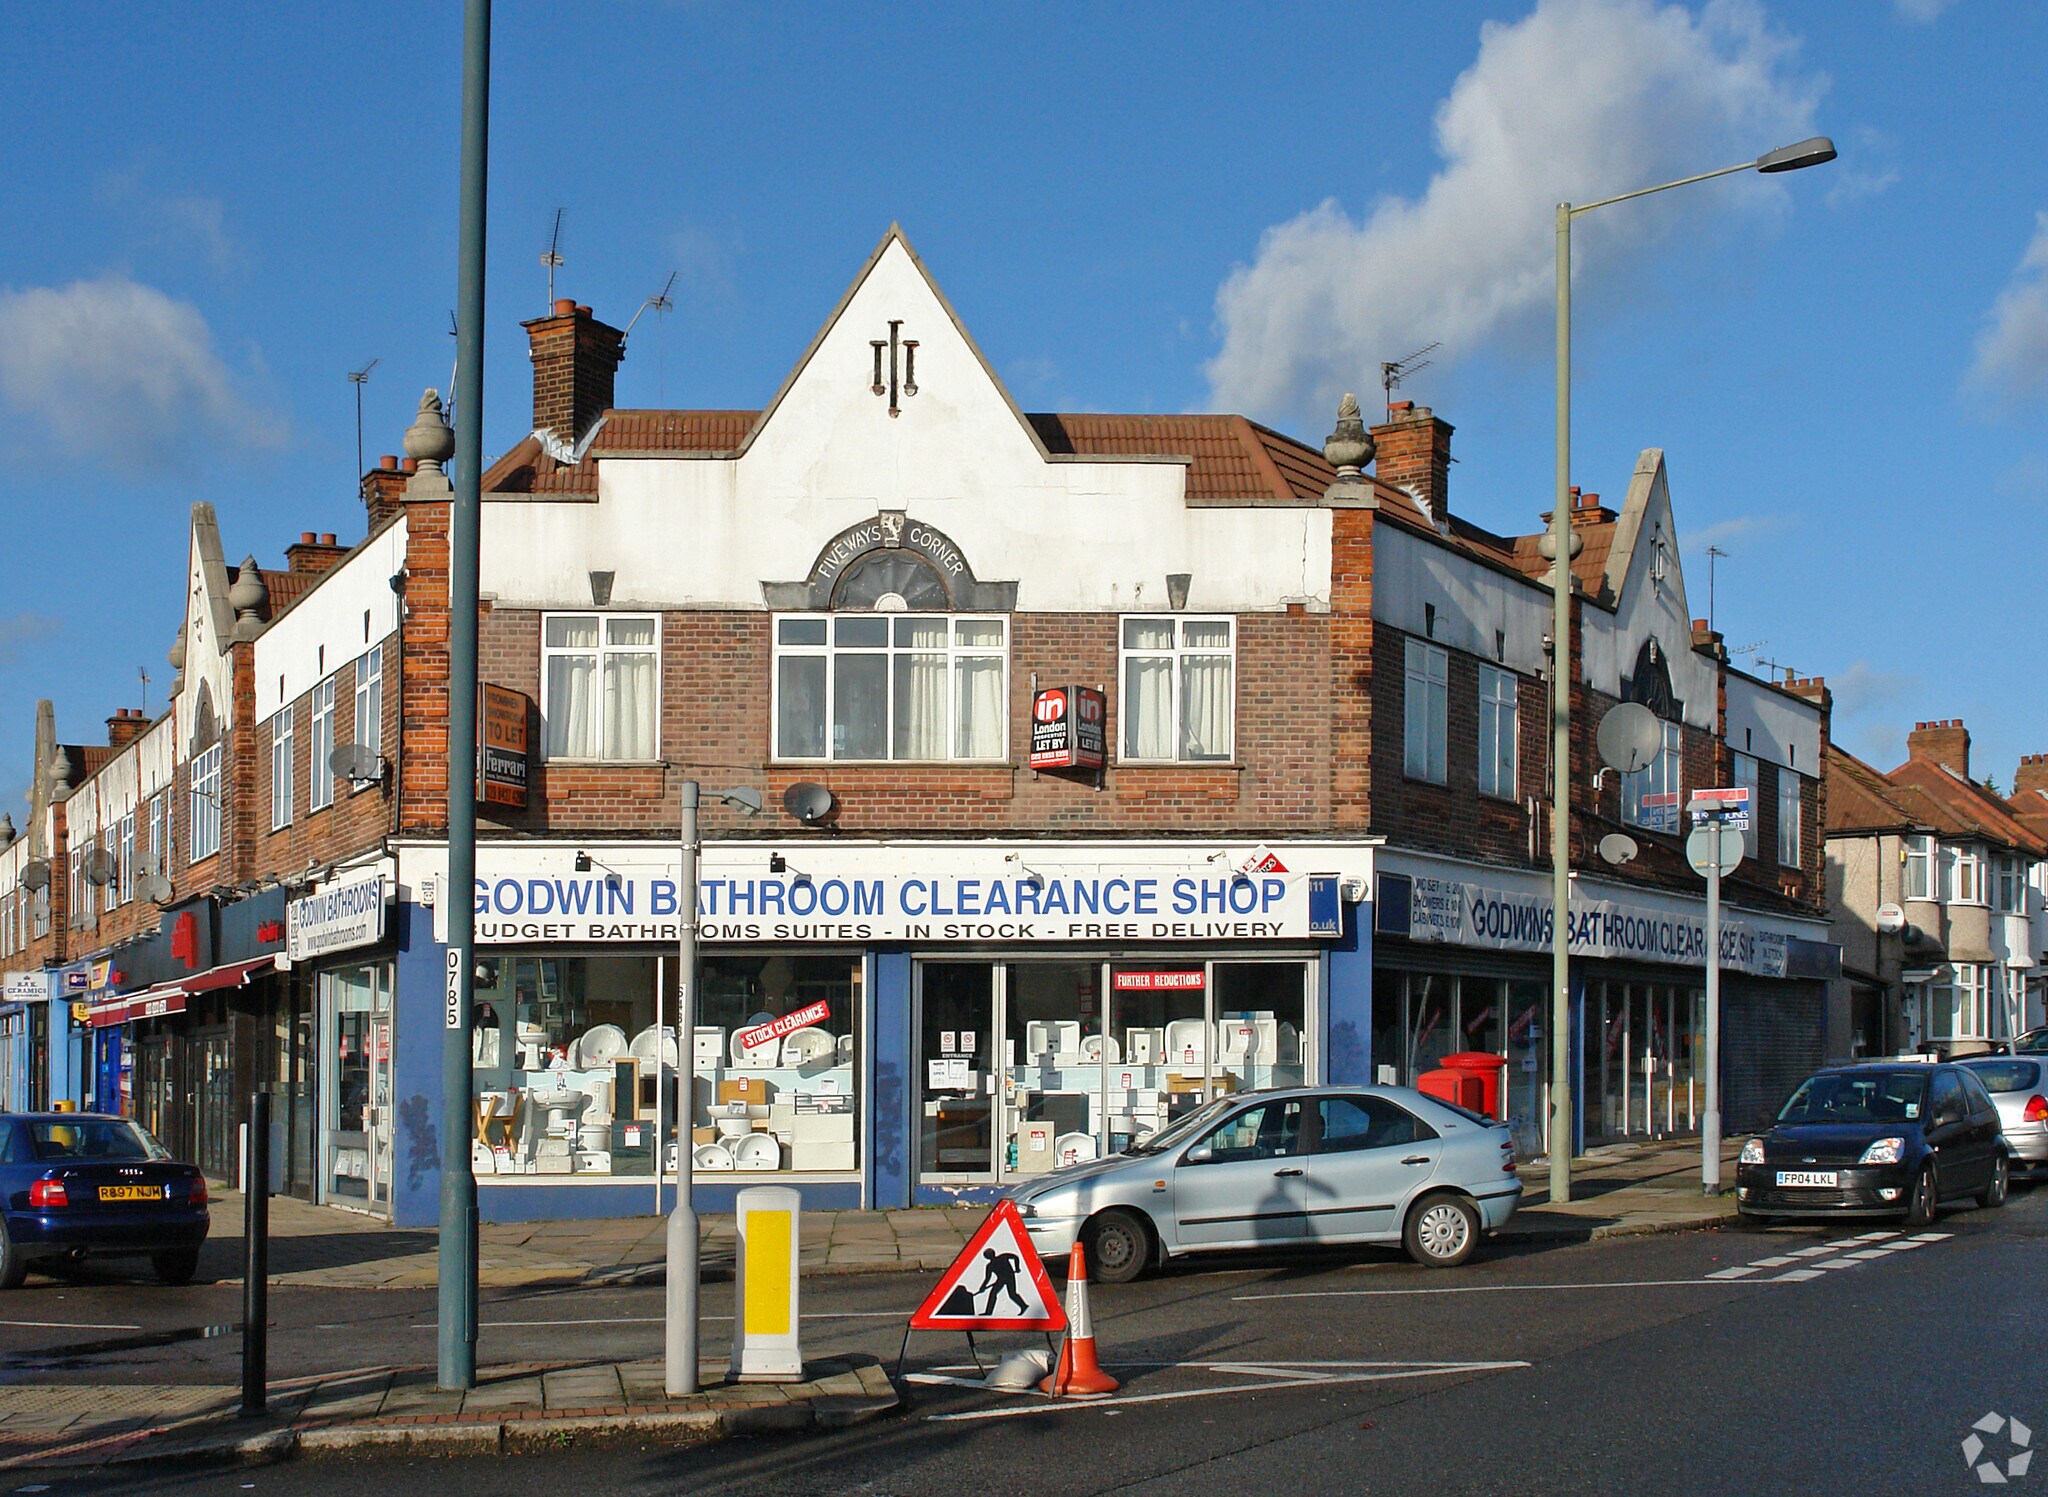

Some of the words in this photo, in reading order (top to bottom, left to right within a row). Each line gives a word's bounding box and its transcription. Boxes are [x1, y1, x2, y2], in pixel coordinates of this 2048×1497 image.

[818, 526, 882, 578] FIVEWAYS
[910, 528, 964, 577] CORNER
[1037, 692, 1063, 721] in
[488, 721, 502, 740] TO
[505, 724, 523, 745] LET
[1034, 721, 1066, 735] London
[1036, 740, 1051, 751] LET
[1052, 738, 1065, 750] BY
[486, 749, 526, 778] Ferrari
[300, 896, 327, 928] GODWIN
[328, 880, 378, 922] BATHROOMS
[900, 879, 1158, 915] CLEARANCE
[1172, 878, 1286, 915] SHOP
[474, 923, 577, 938] UDGET
[589, 924, 761, 938] BATHROMS
[774, 924, 872, 938] SUITES
[905, 924, 930, 938] IN
[944, 923, 1035, 938] STOCK
[1069, 923, 1139, 937] FREE
[1152, 922, 1284, 937] DELIVERY
[1472, 899, 1553, 943] GODWINS
[1567, 911, 1658, 952] BATHROOM
[1661, 921, 1737, 961] CLEARCE
[448, 952, 458, 1025] 0785
[1117, 974, 1150, 987] FURTHER
[1154, 973, 1202, 987] REDUCTIONS
[745, 1026, 775, 1047] STOCK
[774, 1004, 826, 1035] CLEARANCE
[100, 1187, 133, 1199] R897
[1783, 1173, 1811, 1185] FP04
[1813, 1173, 1834, 1185] LKL
